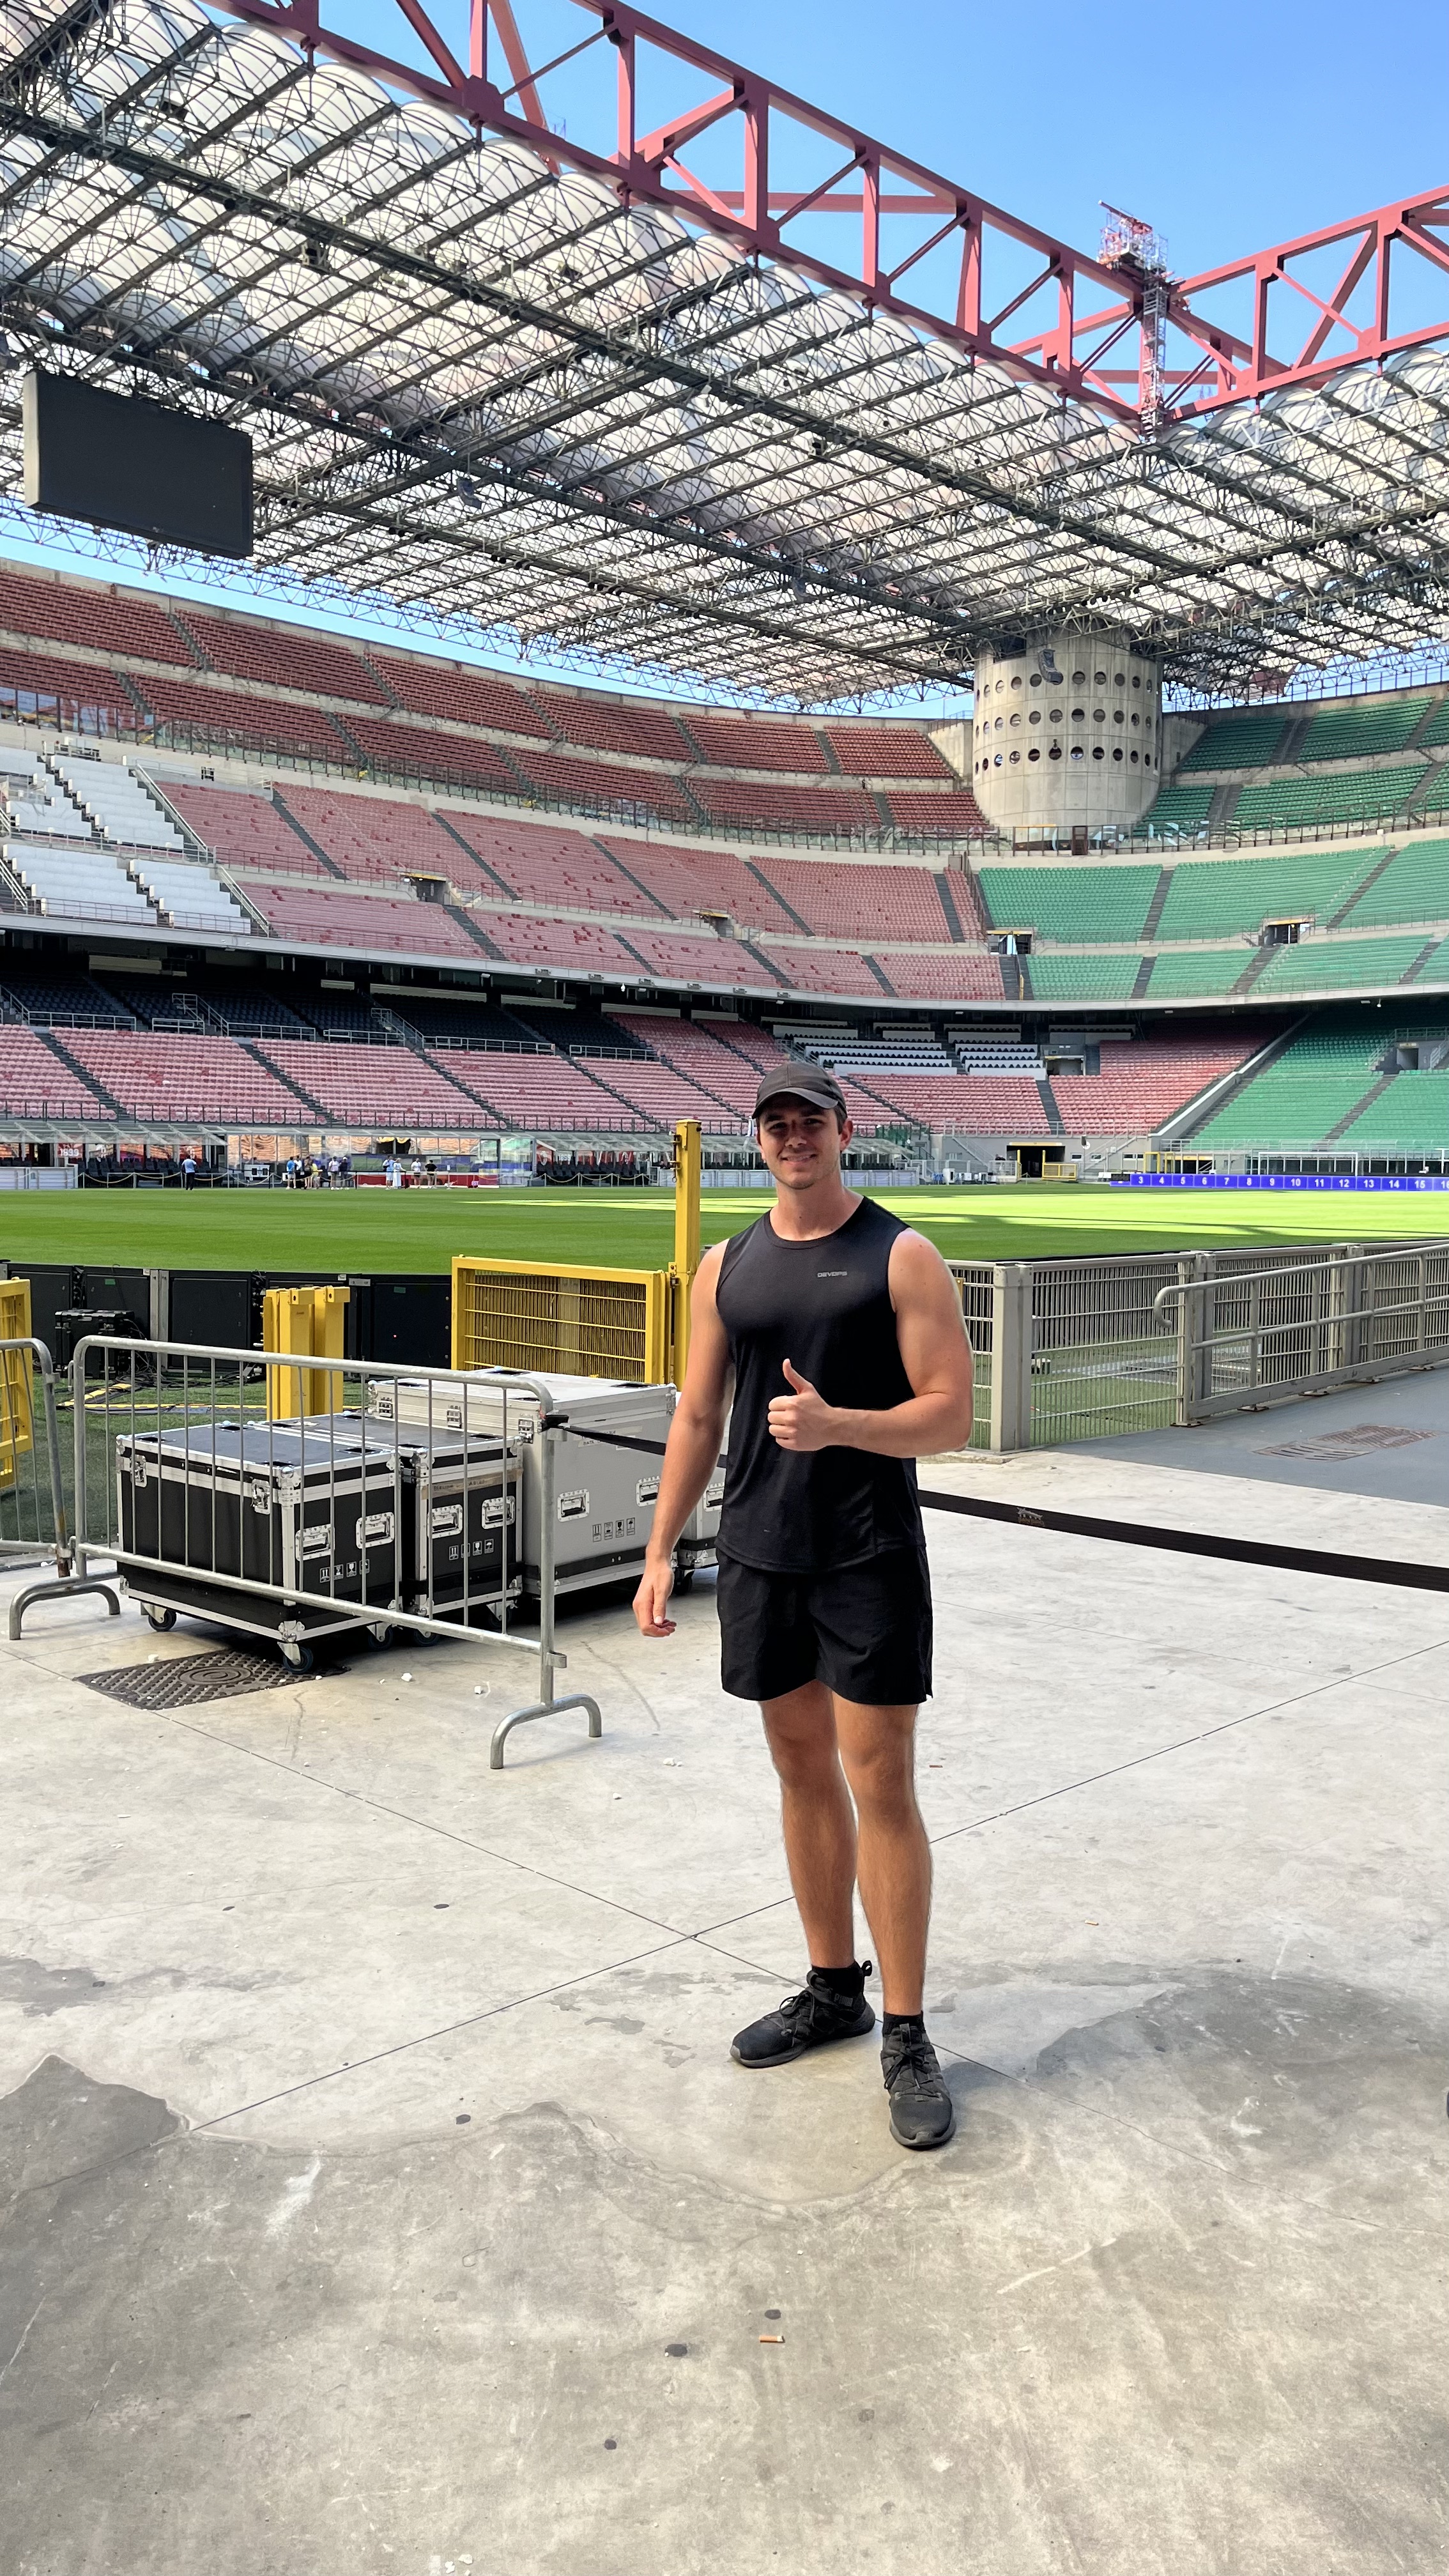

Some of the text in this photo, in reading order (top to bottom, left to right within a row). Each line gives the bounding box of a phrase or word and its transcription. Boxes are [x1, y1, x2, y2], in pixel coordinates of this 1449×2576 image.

[1246, 1177, 1252, 1186] 8
[1269, 1178, 1275, 1186] 9
[1291, 1178, 1301, 1186] 10
[1314, 1179, 1324, 1187] 11
[1338, 1179, 1349, 1188] 12
[1363, 1179, 1374, 1188] 13
[1388, 1180, 1400, 1188] 14
[1414, 1180, 1425, 1188] 15
